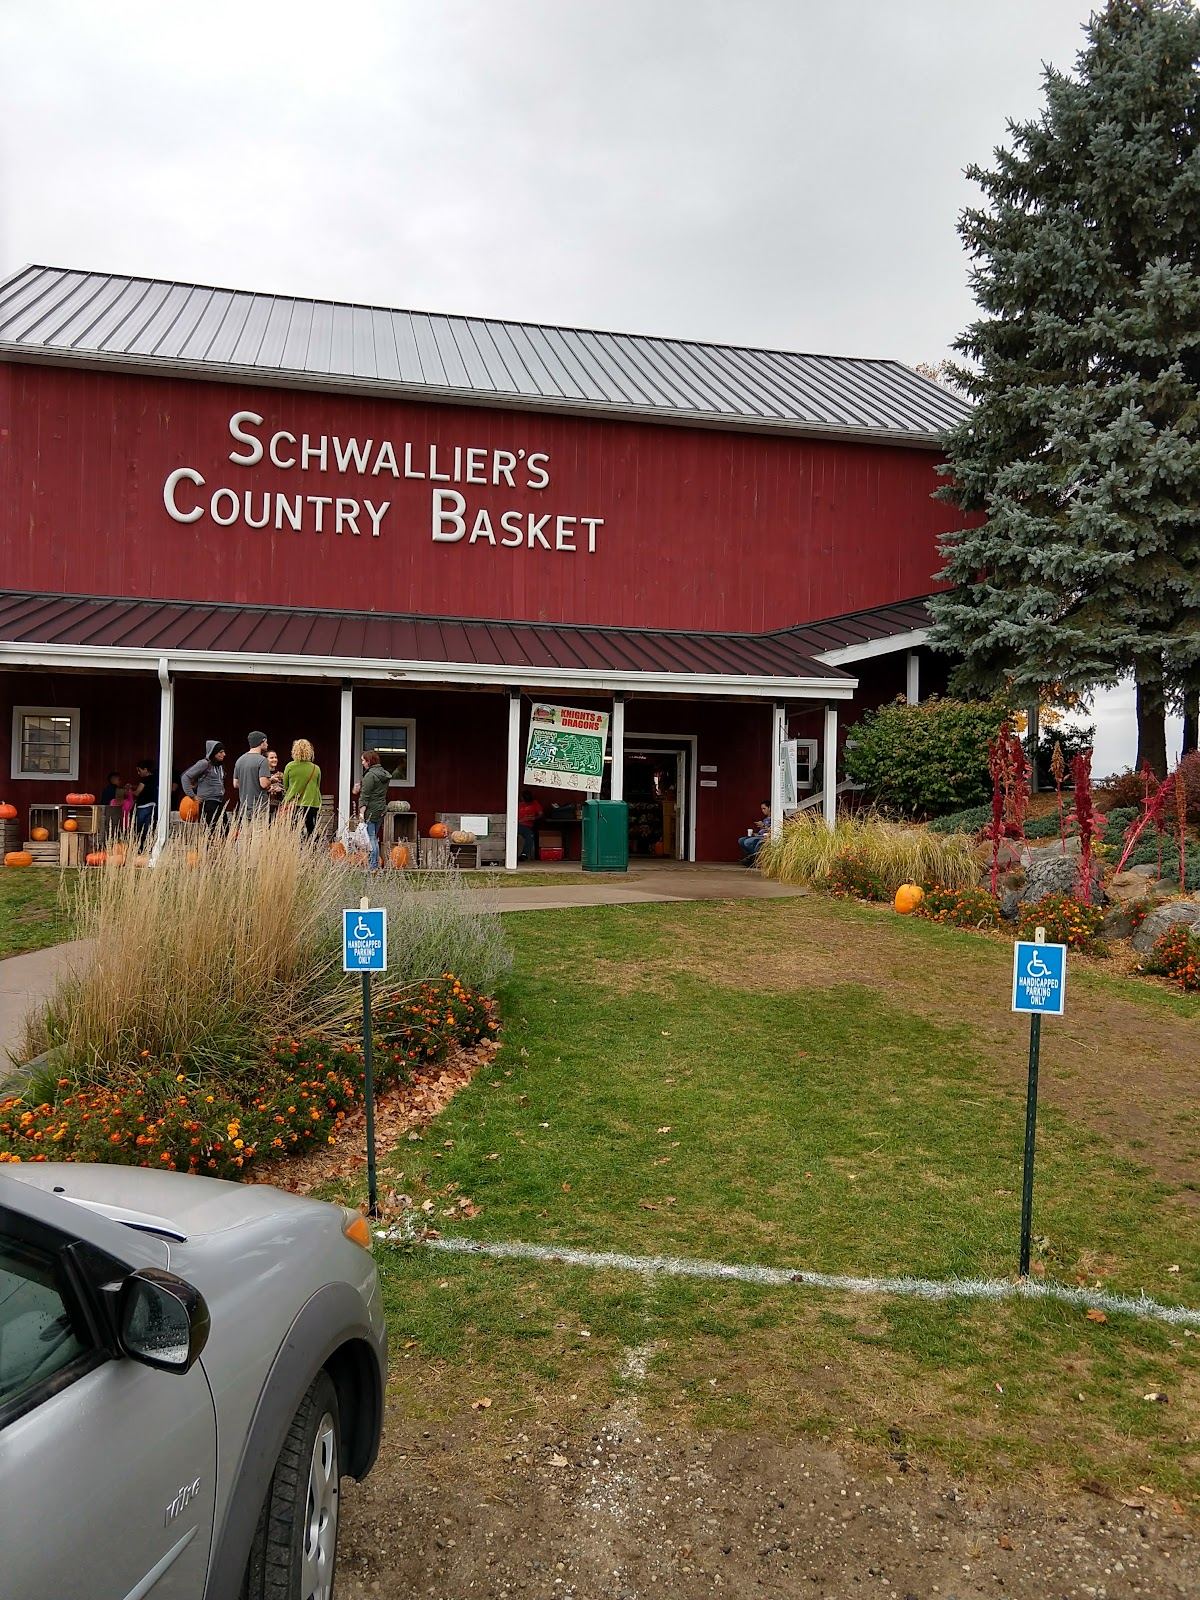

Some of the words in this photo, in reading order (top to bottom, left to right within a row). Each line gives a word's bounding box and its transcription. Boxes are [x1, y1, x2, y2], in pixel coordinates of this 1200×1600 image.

[228, 410, 550, 489] SCHWALLIER'S
[163, 467, 391, 537] COUNTRY
[432, 488, 605, 553] BASKET
[560, 709, 596, 721] KNIGHTS
[561, 718, 599, 730] DRAGONS
[347, 940, 381, 949] HANDICAPPED
[354, 948, 375, 956] PARKING
[358, 956, 370, 964] ONLY
[1019, 977, 1059, 988] HANDICAPPED
[1026, 986, 1051, 997] PARKING
[1030, 996, 1046, 1005] ONLY
